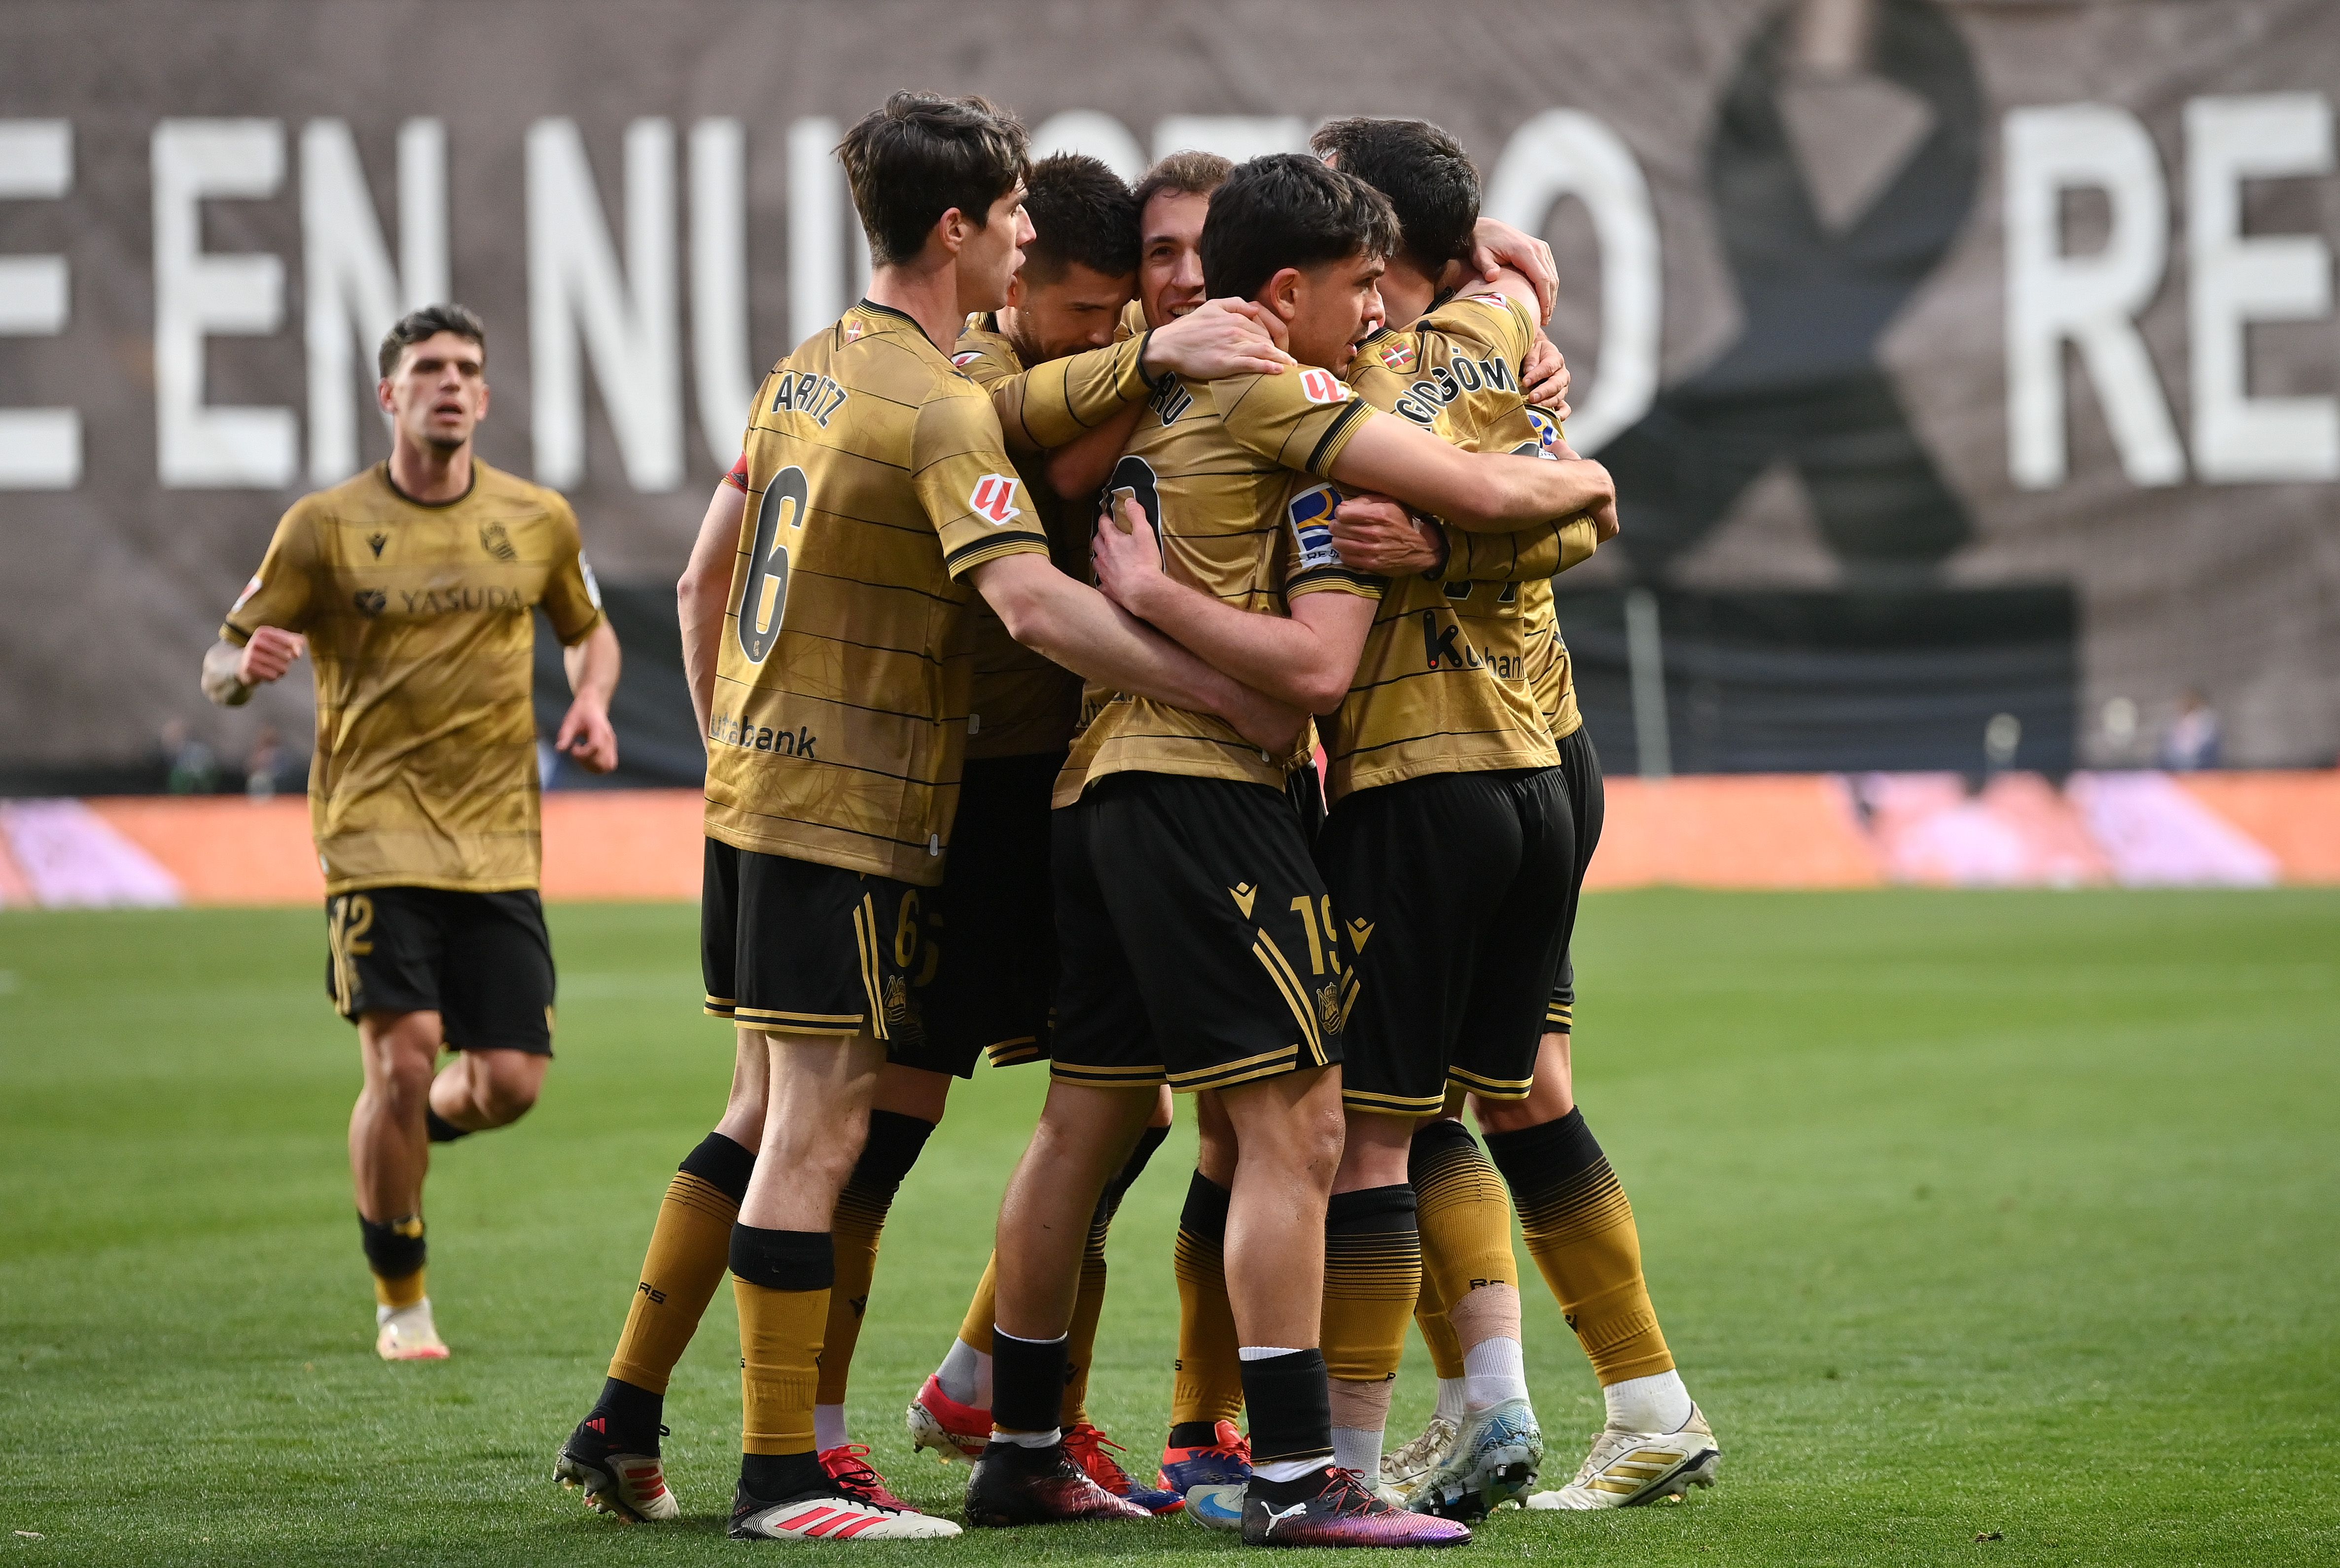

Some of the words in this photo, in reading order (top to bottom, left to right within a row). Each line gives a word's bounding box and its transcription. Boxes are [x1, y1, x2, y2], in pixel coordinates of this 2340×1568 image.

[150, 117, 452, 489] EN
[2003, 93, 2340, 488] RE
[771, 372, 848, 428] ARITZ
[1395, 380, 1446, 432] GIO
[737, 465, 809, 665] 6
[398, 585, 522, 613] YASUDA
[895, 889, 919, 967] 6
[638, 1282, 667, 1304] RS
